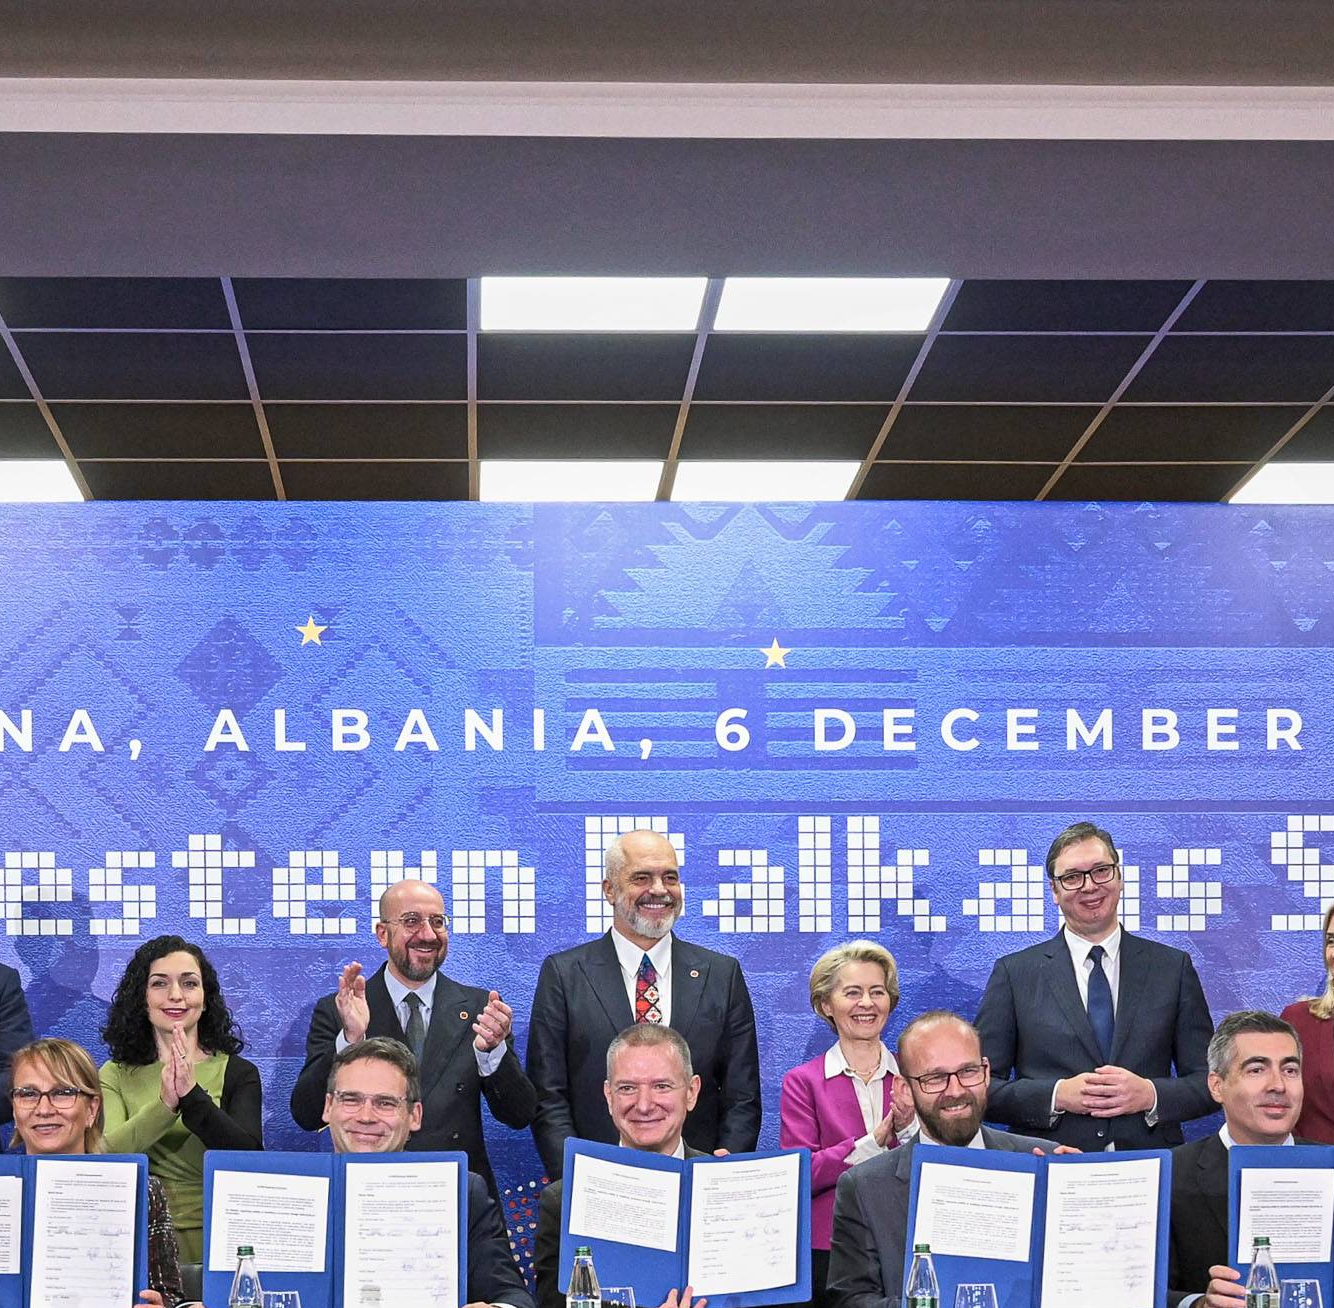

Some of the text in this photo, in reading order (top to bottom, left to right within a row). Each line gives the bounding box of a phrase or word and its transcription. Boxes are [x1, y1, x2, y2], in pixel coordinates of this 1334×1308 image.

[203, 708, 654, 760] ALBANIA,
[715, 707, 751, 752] 6
[813, 707, 1305, 752] DECEMBER
